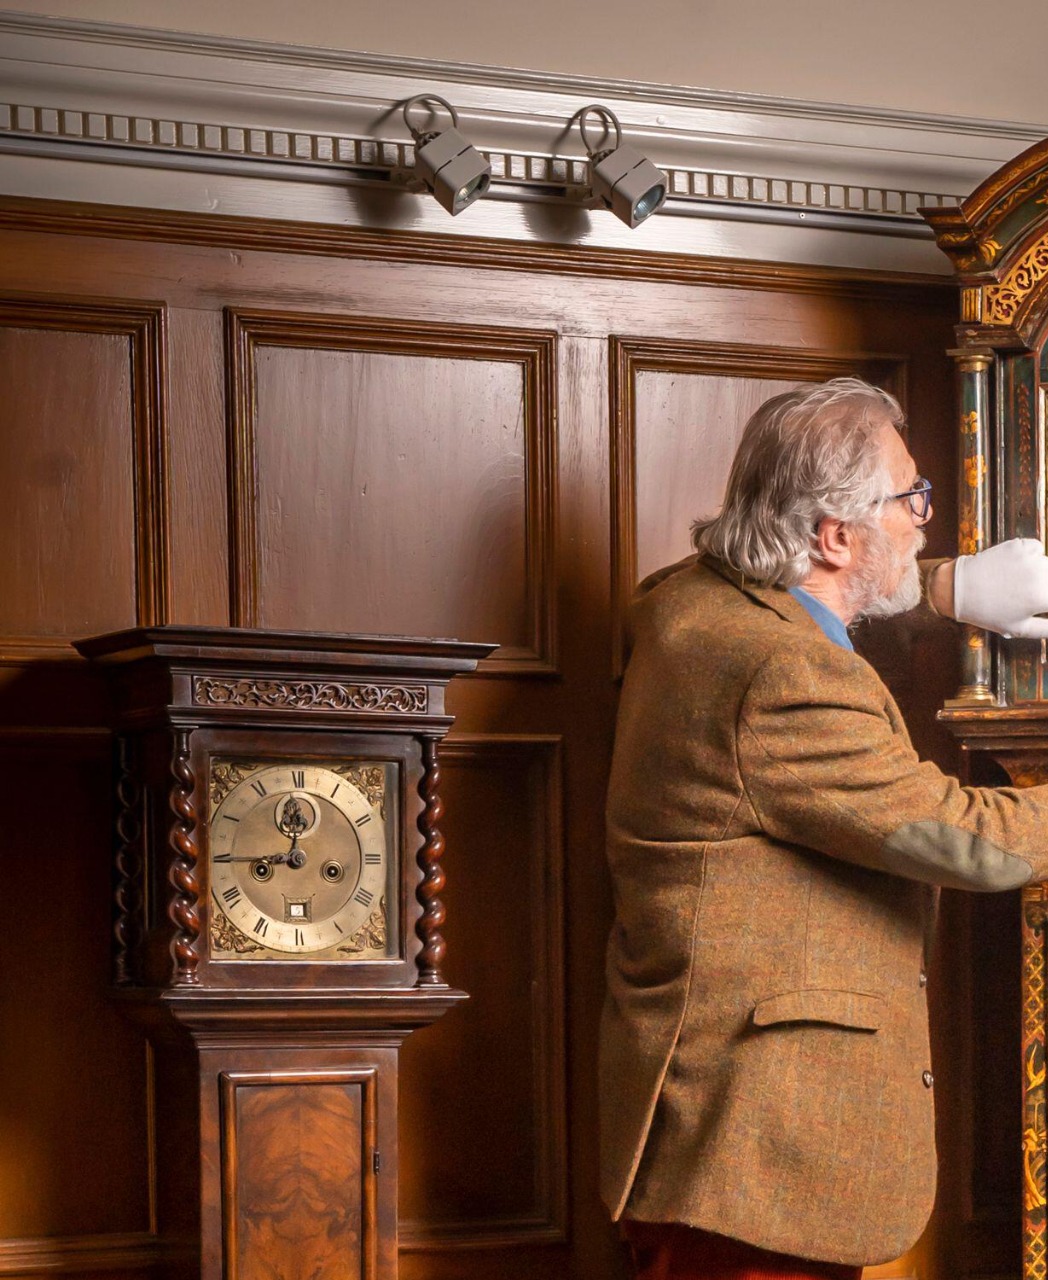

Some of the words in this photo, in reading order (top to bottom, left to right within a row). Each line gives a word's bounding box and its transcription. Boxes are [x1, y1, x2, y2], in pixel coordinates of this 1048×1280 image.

[330, 783, 340, 798] I
[355, 813, 371, 828] II
[365, 853, 381, 865] III
[354, 887, 374, 908] IIII
